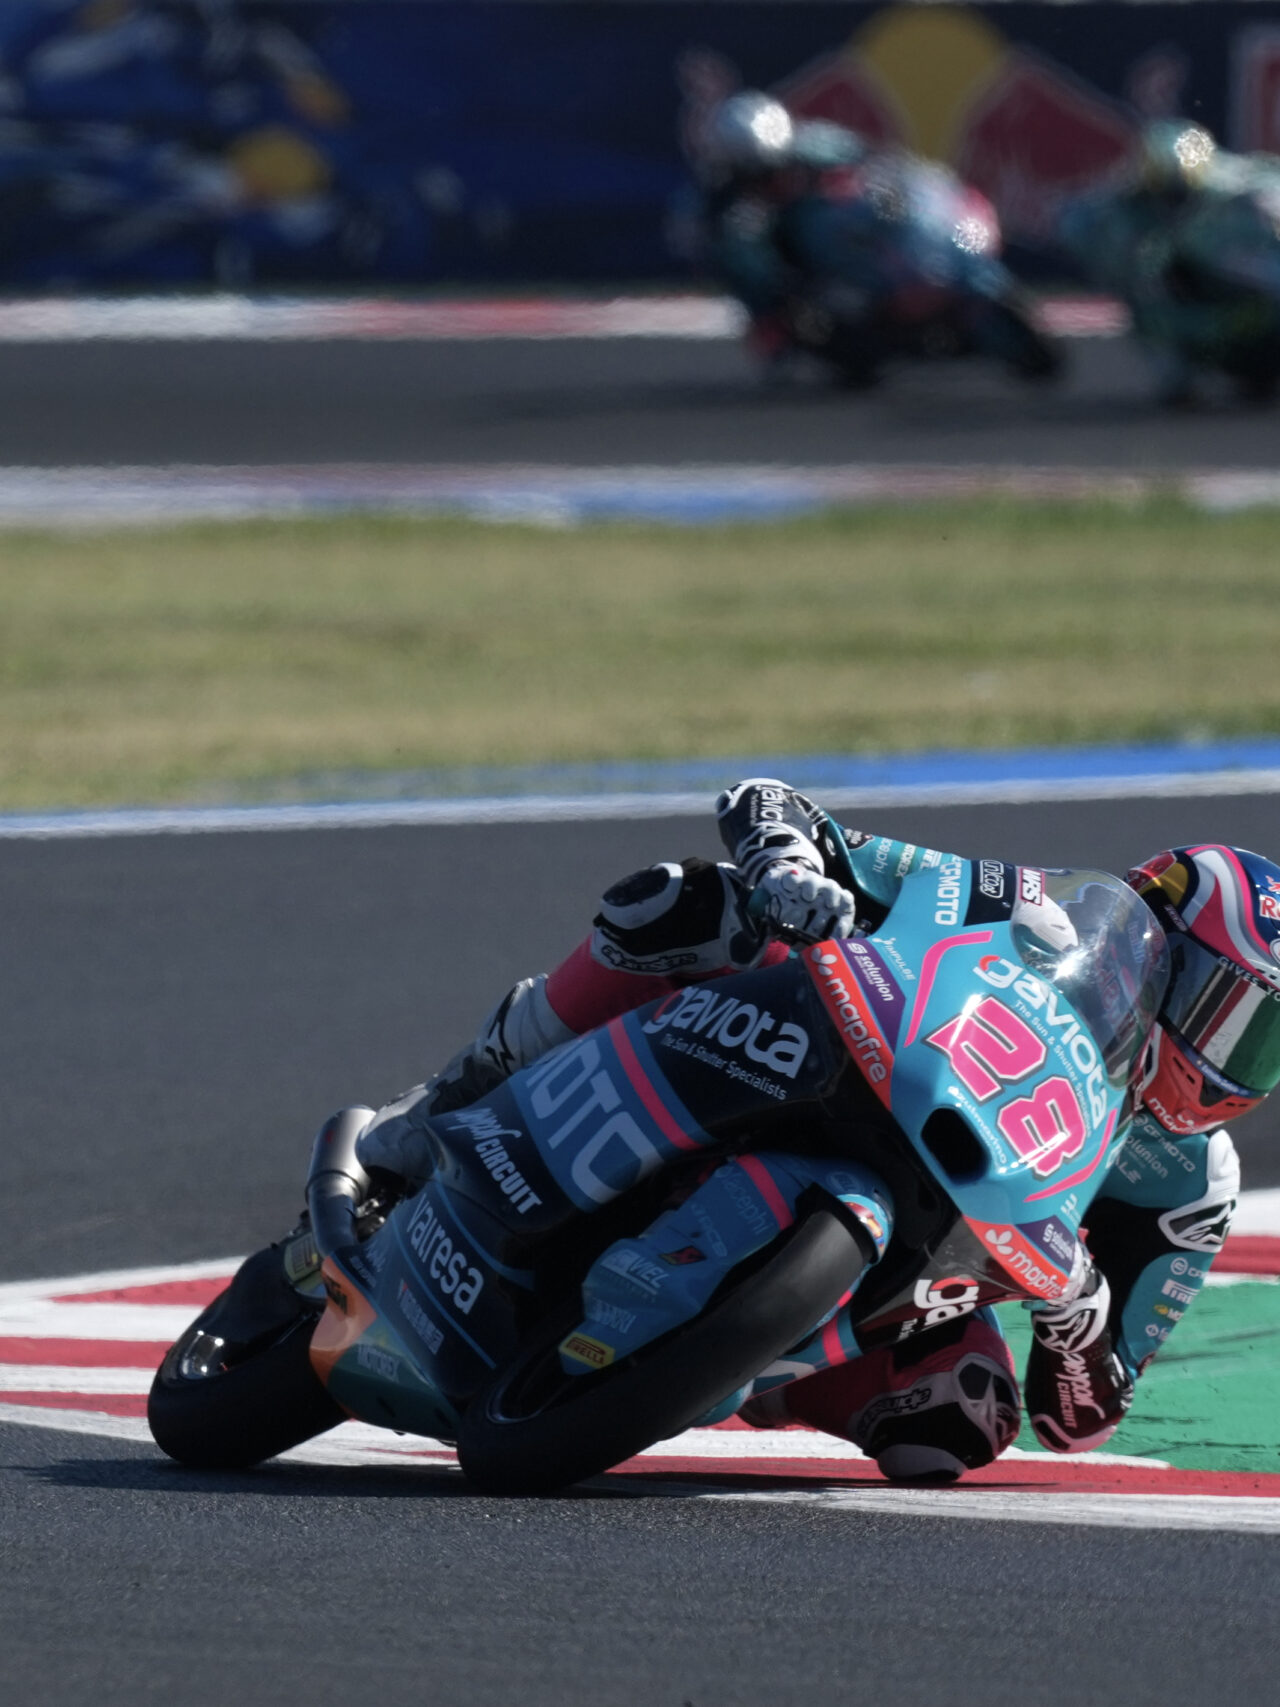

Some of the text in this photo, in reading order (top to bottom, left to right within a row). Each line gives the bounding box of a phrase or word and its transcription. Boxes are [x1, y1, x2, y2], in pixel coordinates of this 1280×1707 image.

[934, 855, 963, 927] CFMOTO
[1021, 868, 1043, 905] WRS
[862, 953, 895, 1002] solunion
[1218, 956, 1260, 989] GIVES
[641, 985, 811, 1081] gaviota
[829, 977, 887, 1084] mapfre
[972, 954, 1107, 1130] gaviota
[1014, 999, 1031, 1017] The
[1031, 1013, 1050, 1038] Sun
[1054, 1045, 1080, 1083] Shutter
[695, 1045, 728, 1071] Shutter
[725, 1060, 788, 1101] Specialists
[921, 994, 1088, 1180] 28
[475, 1140, 543, 1215] CIRCUIT
[1125, 1136, 1169, 1180] olunion
[1008, 1249, 1066, 1301] mapfre
[1055, 1379, 1078, 1430] CIRCUIT
